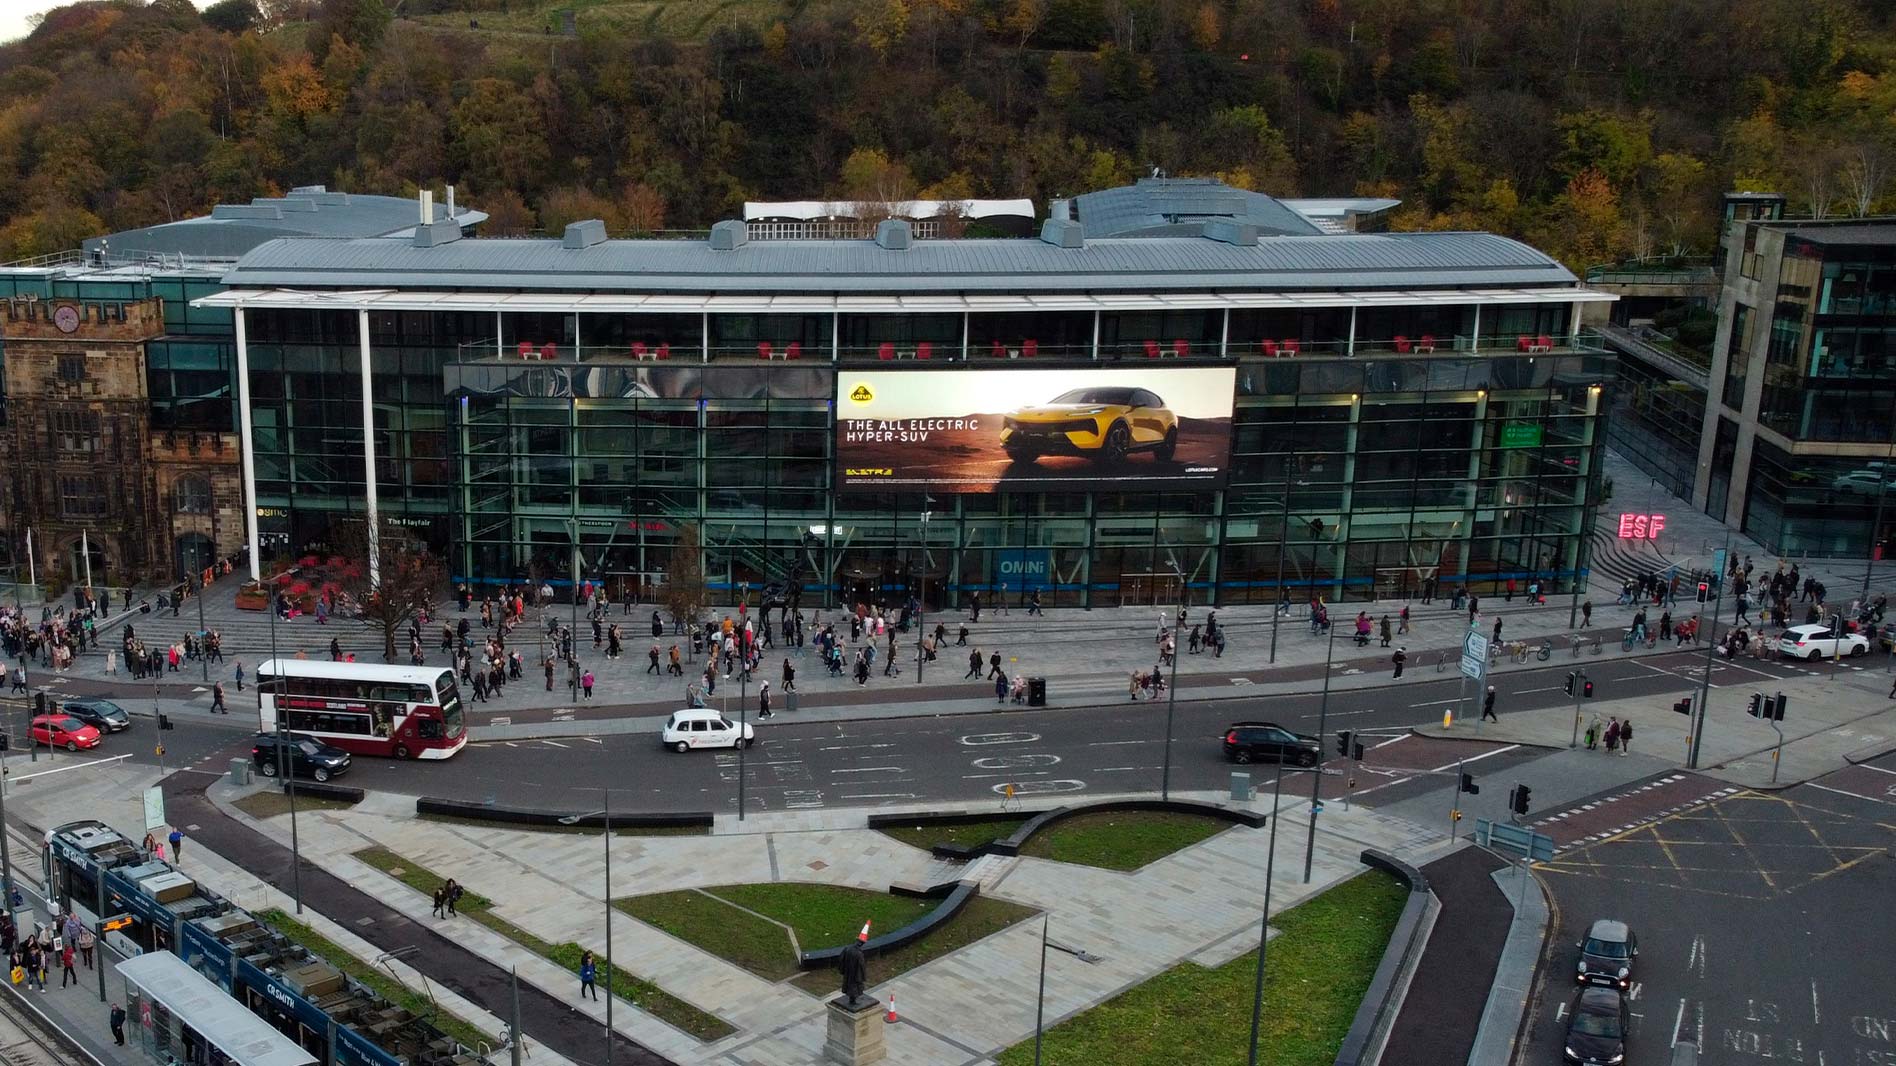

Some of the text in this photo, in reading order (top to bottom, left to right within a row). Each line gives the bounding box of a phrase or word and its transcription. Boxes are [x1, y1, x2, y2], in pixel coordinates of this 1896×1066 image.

[847, 419, 979, 431] THE ALL ELECTRIC
[846, 431, 929, 442] HYPER-SUV
[387, 518, 401, 526] The
[1619, 513, 1666, 539] ESF
[267, 983, 295, 1009] CR SMITH
